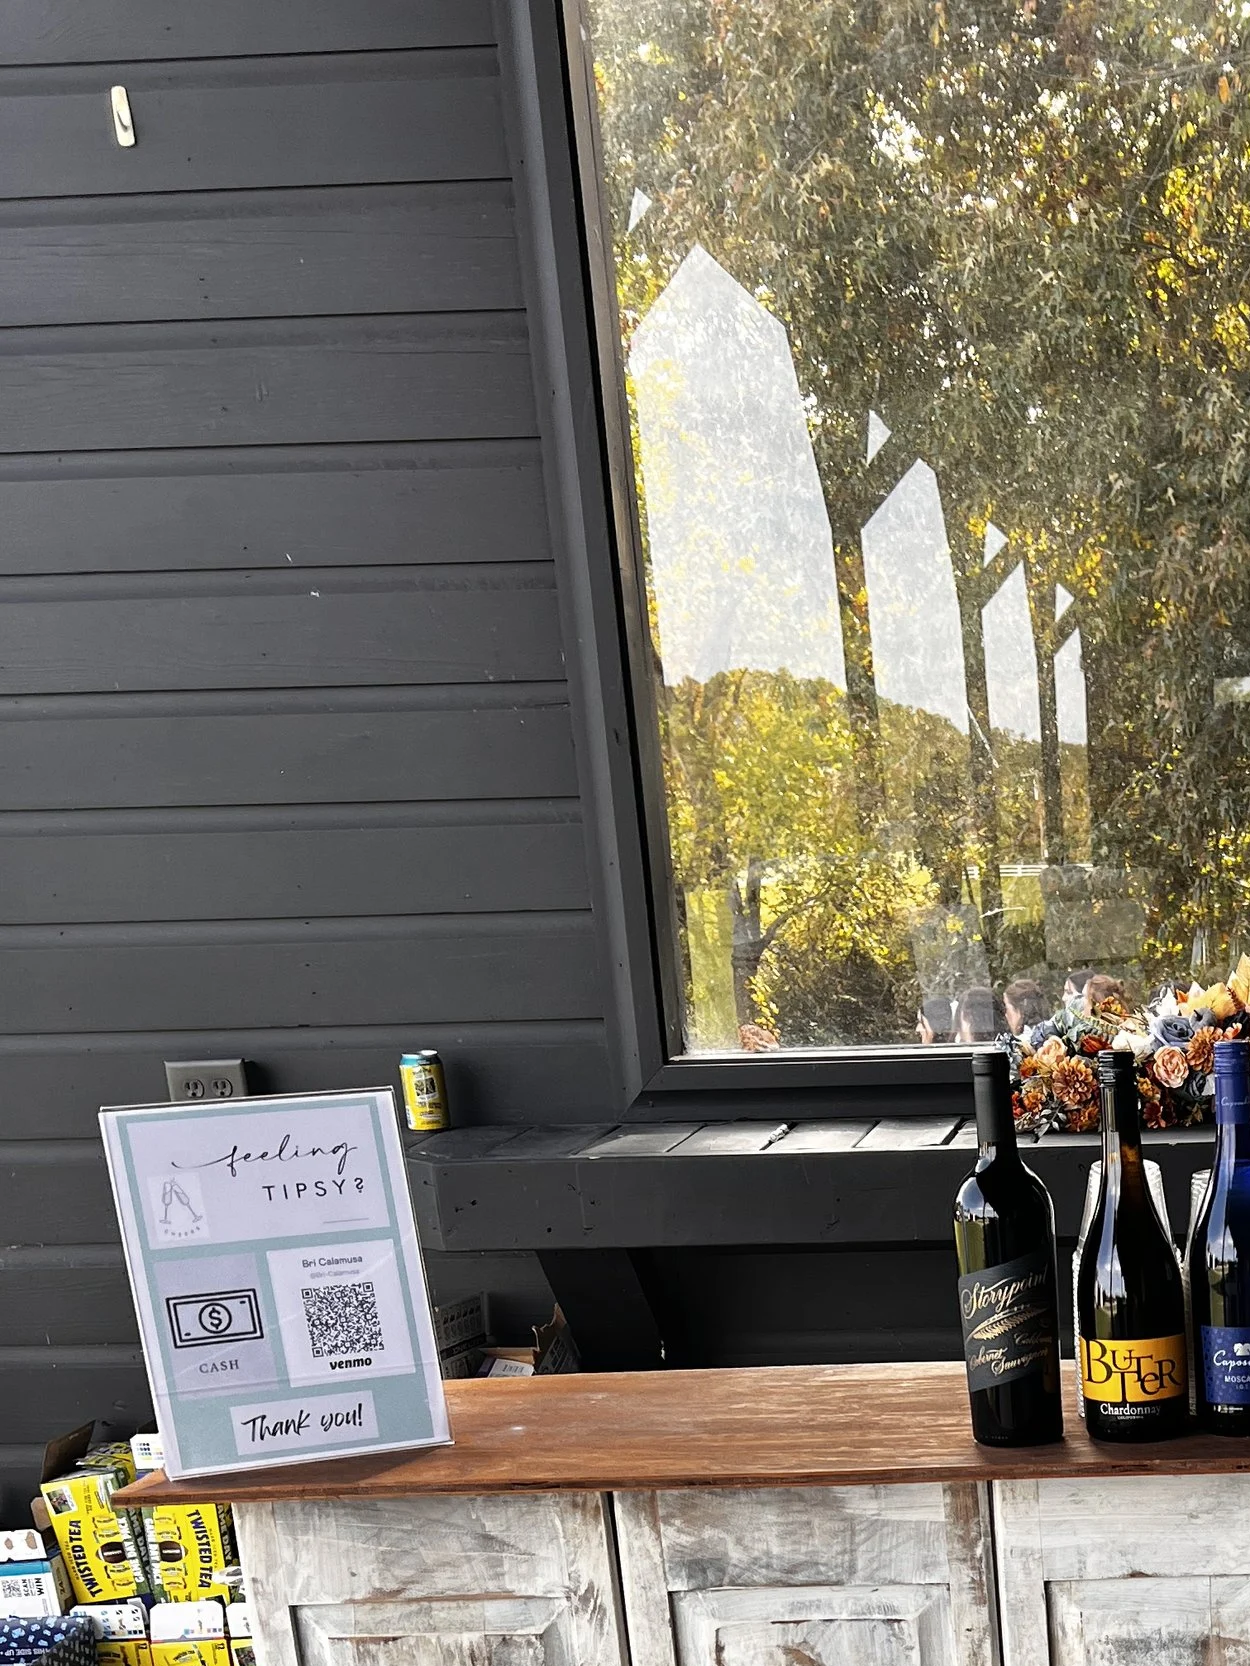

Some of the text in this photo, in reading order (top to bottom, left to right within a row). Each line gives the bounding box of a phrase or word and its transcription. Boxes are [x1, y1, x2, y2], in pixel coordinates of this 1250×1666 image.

[171, 1134, 358, 1178] feeling
[262, 1177, 365, 1202] TIPSY?
[302, 1255, 363, 1268] Bri Calamusa
[961, 1263, 1049, 1319] Storypoint
[199, 1359, 240, 1374] CASH
[329, 1356, 373, 1371] venmo
[1100, 1402, 1161, 1416] Chardonnay
[241, 1403, 363, 1442] Thank you!
[217, 1504, 228, 1532] AME
[69, 1519, 103, 1598] TWISTED TEA
[117, 1516, 145, 1583] GAME DAY PACK
[187, 1509, 213, 1589] TWISTED TEA
[22, 1578, 30, 1597] SCAN
[34, 1577, 45, 1596] WIN
[4, 1648, 15, 1656] UP
